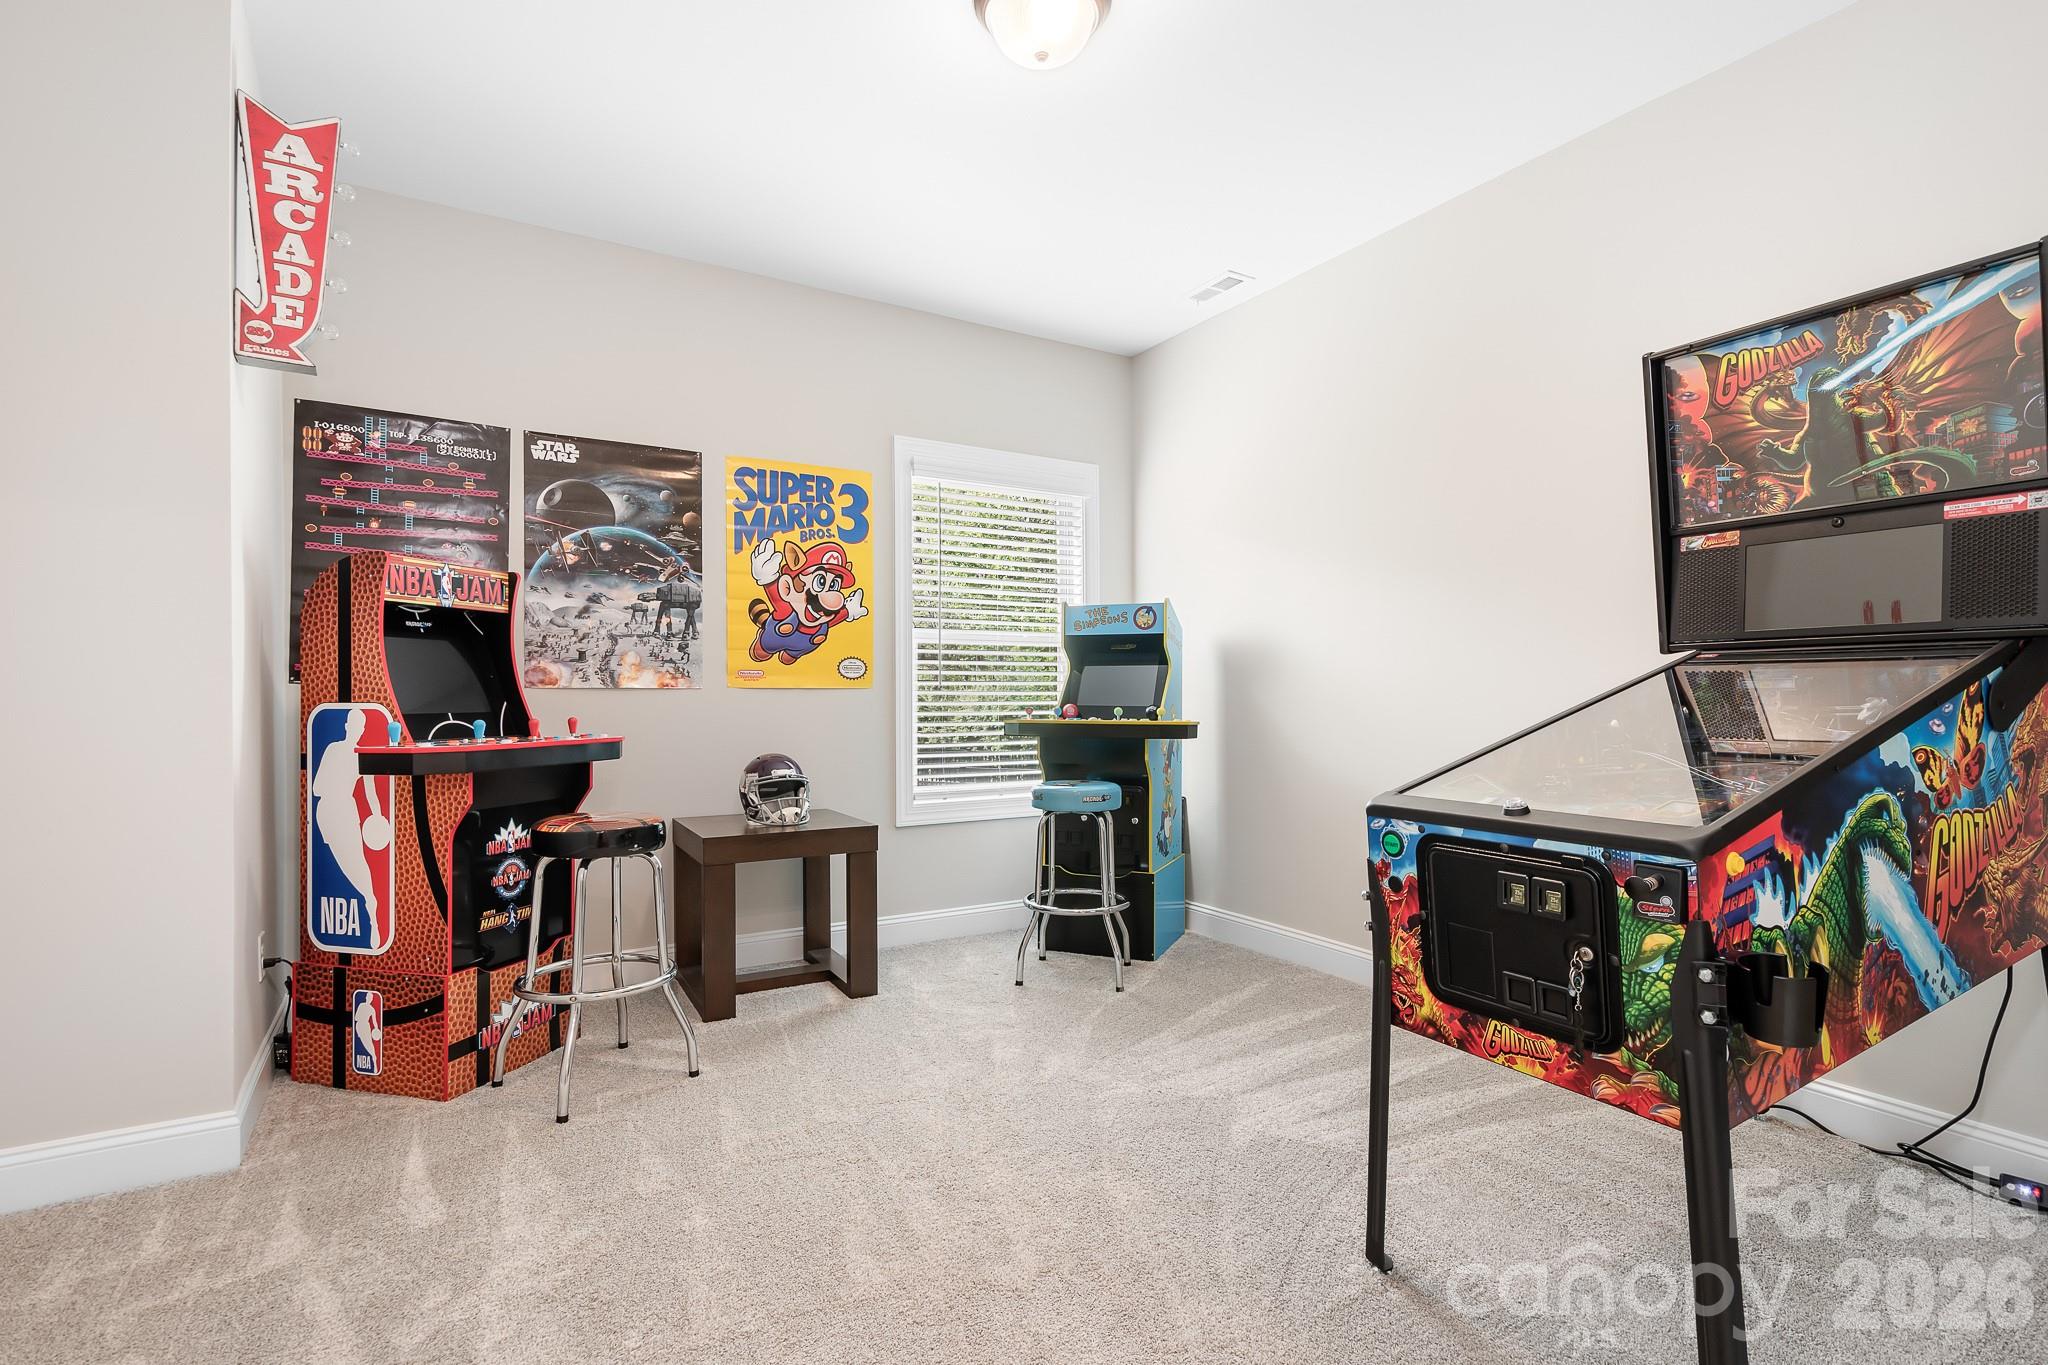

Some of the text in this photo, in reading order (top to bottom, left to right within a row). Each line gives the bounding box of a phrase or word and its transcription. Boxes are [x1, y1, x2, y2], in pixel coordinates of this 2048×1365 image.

[262, 133, 324, 330] ARCADE
[244, 343, 290, 357] games
[1713, 329, 1825, 407] GODZILLA
[531, 439, 579, 454] STAR
[531, 449, 580, 464] WARS
[732, 466, 836, 512] SUPER
[837, 483, 870, 545] 3
[733, 502, 836, 555] MARIO
[799, 528, 836, 544] BROS.
[388, 563, 504, 606] NBA JAM
[1073, 611, 1129, 632] SIMPSONS
[1085, 606, 1110, 618] THE
[488, 840, 506, 855] NBA
[1926, 782, 2023, 944] GODZILLA
[492, 868, 530, 887] NBA JAM
[320, 896, 361, 937] NBA
[480, 913, 509, 930] HANG
[524, 1003, 553, 1031] JAM
[1484, 1019, 1554, 1062] GODZILLA
[356, 1053, 372, 1070] NBA
